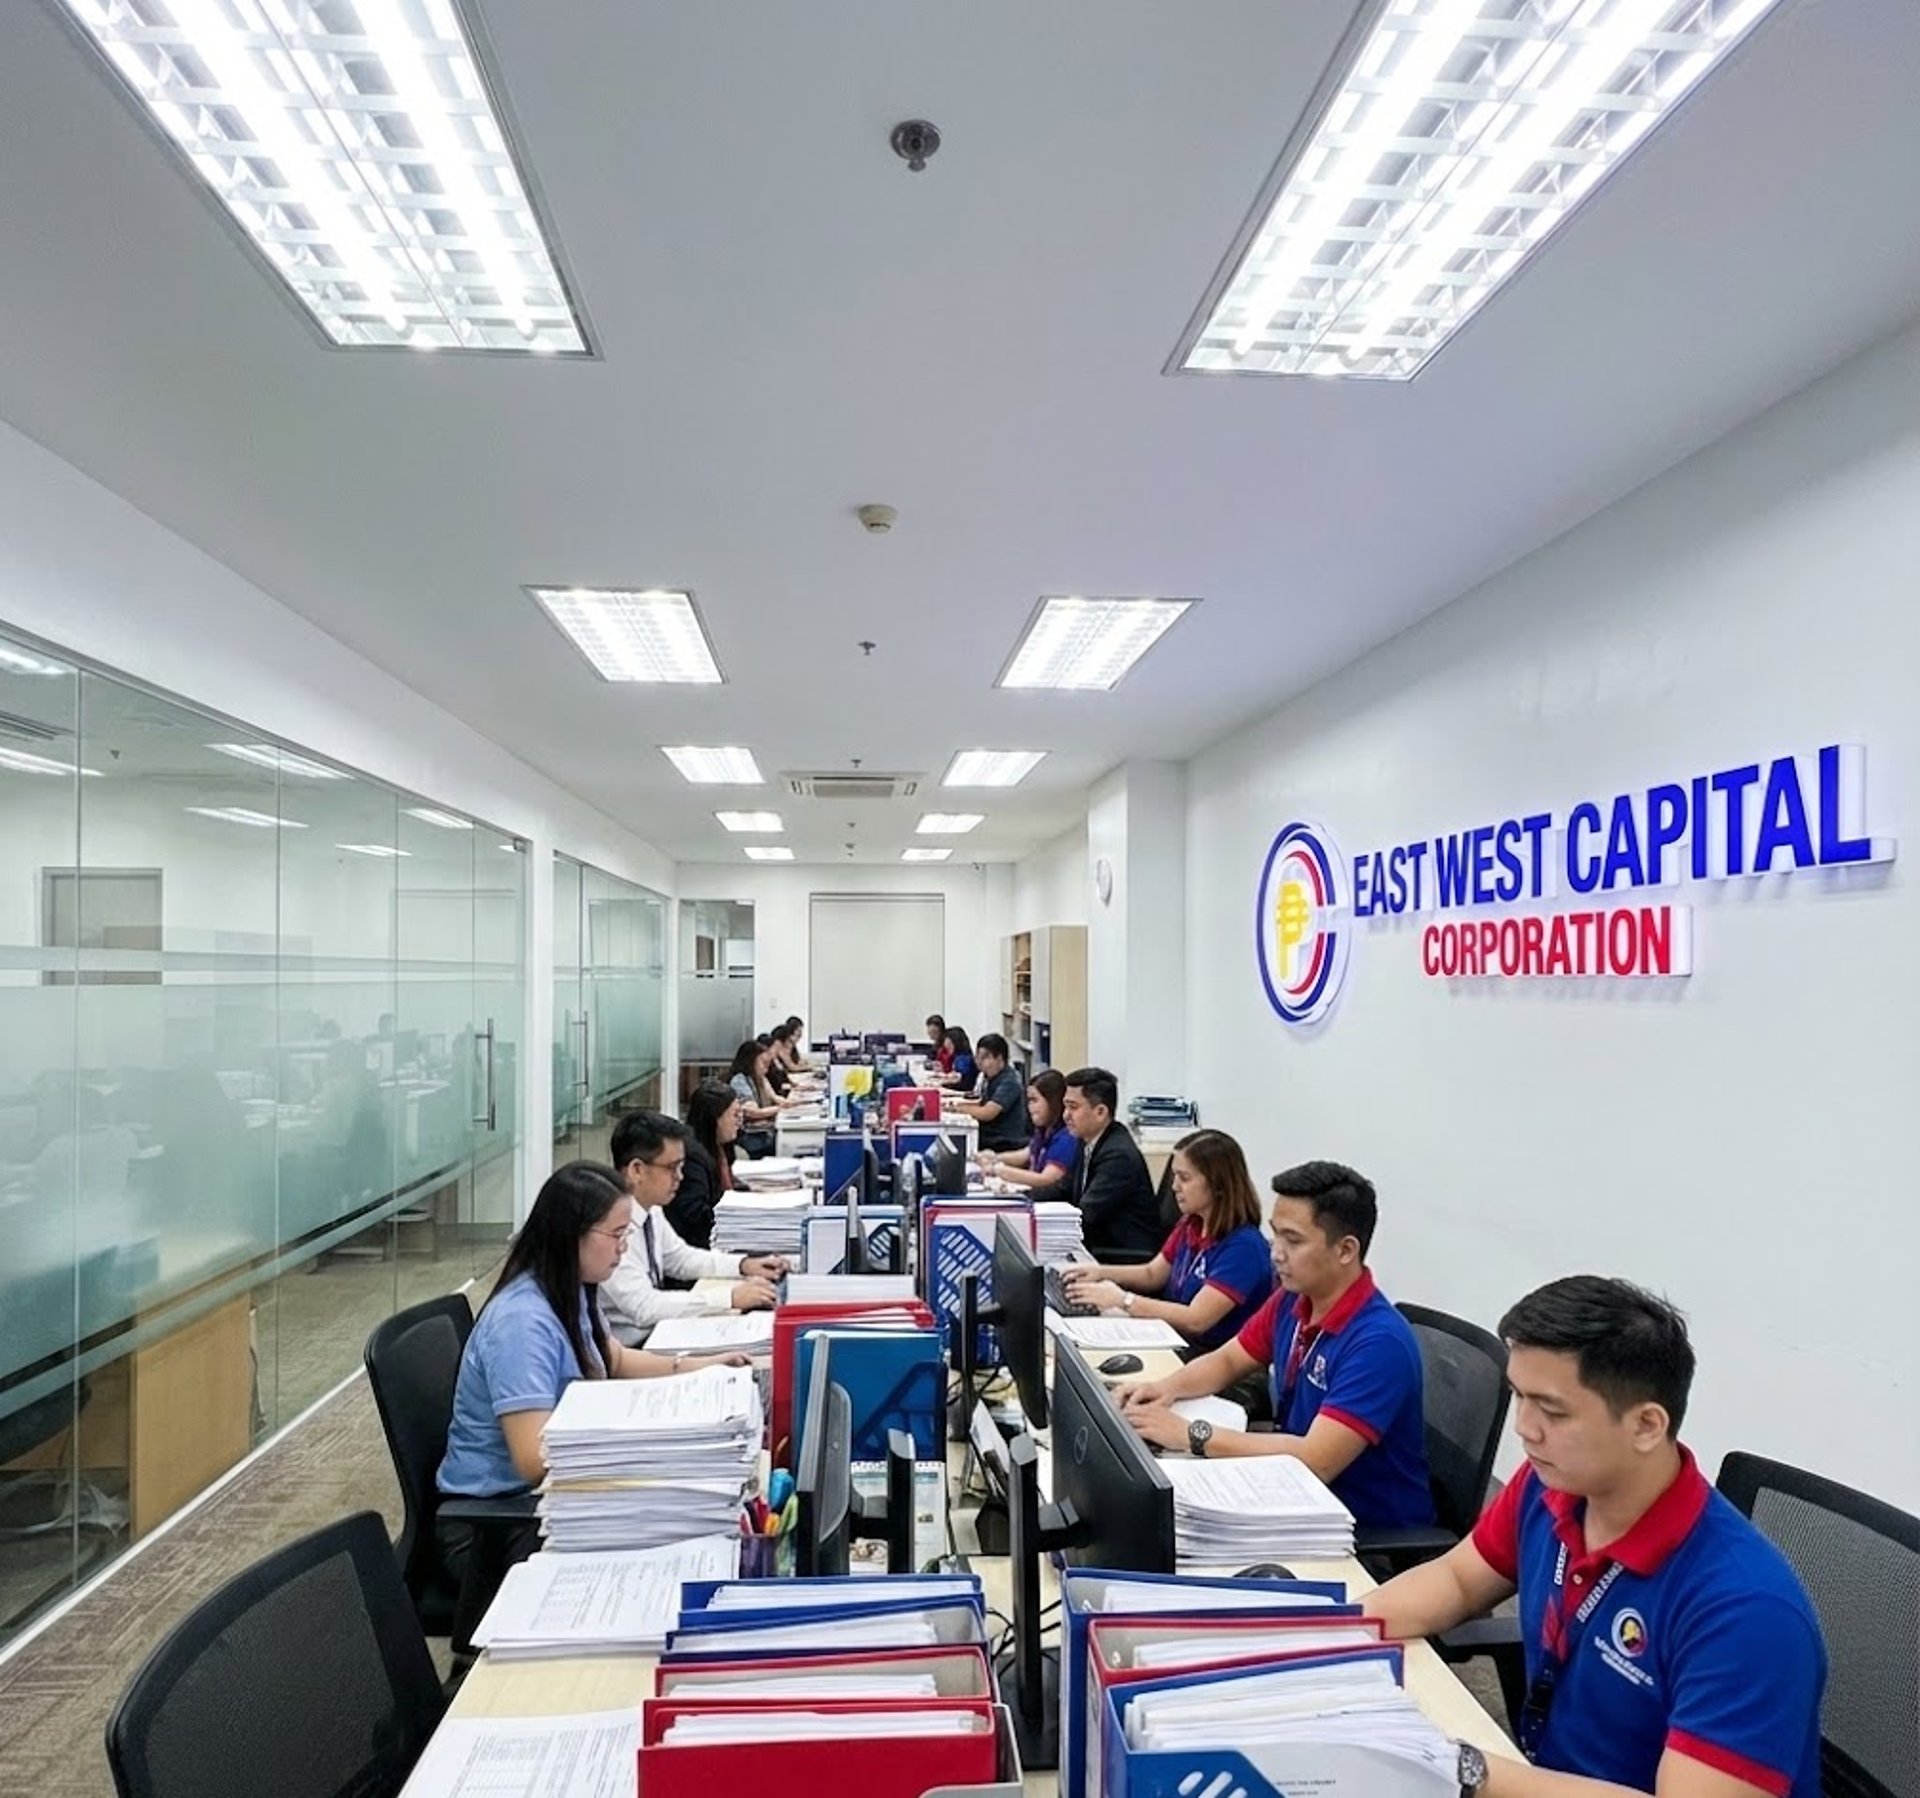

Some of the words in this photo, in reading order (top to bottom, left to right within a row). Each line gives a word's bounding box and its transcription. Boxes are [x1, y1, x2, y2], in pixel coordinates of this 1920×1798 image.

[1354, 841, 1428, 917] EAST
[1436, 813, 1552, 908] WEST
[1566, 745, 1873, 894] CAPITAL
[1423, 907, 1672, 976] CORPORATION
